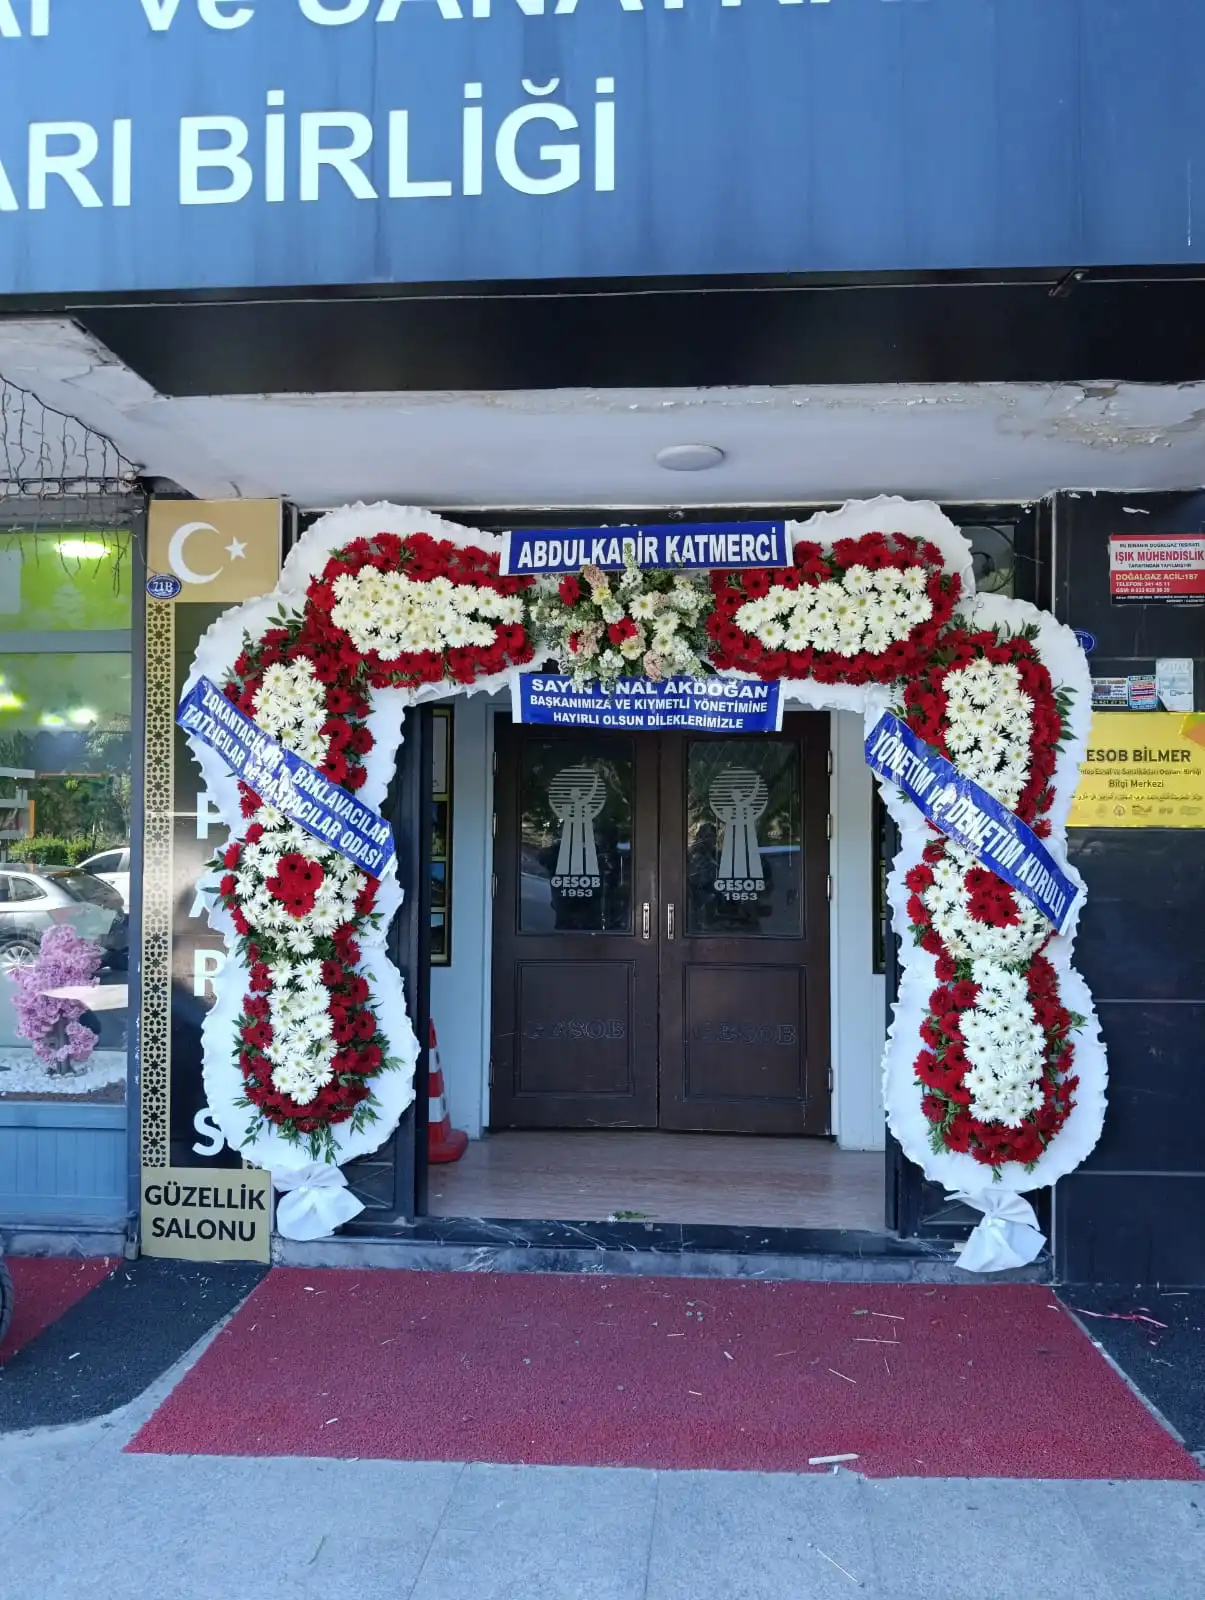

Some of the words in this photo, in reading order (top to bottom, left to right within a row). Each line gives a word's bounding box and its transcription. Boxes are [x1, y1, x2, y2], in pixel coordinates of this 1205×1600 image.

[0, 119, 132, 211] RI
[180, 77, 617, 205] BİRLİĞİ
[517, 531, 659, 567] ABDULKADİR
[665, 526, 778, 563] KATMERCİ
[1137, 548, 1205, 562] MÜHENDİSLİK
[1115, 572, 1162, 581] DOĞALGAZ
[664, 679, 768, 698] AKDOĞAN
[530, 694, 612, 710] BAŞKANIMIZA
[614, 698, 632, 710] VE
[634, 697, 691, 711] KIYMETLİ
[694, 698, 768, 713] YÖNETİMİNE
[553, 711, 600, 724] HAYIRLI
[602, 713, 646, 727] OLSUN
[647, 712, 744, 729] DİLEKLERİMİZLE
[1132, 745, 1192, 762] BİLMER
[1108, 779, 1128, 789] Bilgi
[1130, 779, 1165, 788] Merkezi
[291, 766, 391, 846] BAKLAVACILAR
[870, 727, 937, 796] YÖNETİM
[1016, 852, 1067, 917] KURULU
[340, 829, 384, 869] ODASI
[550, 876, 601, 888] GESOB
[713, 879, 766, 892] GESOB
[560, 888, 594, 898] 1953
[724, 892, 759, 901] 1953
[144, 1180, 266, 1211] GÜZELLİK
[151, 1216, 256, 1242] SALONU
